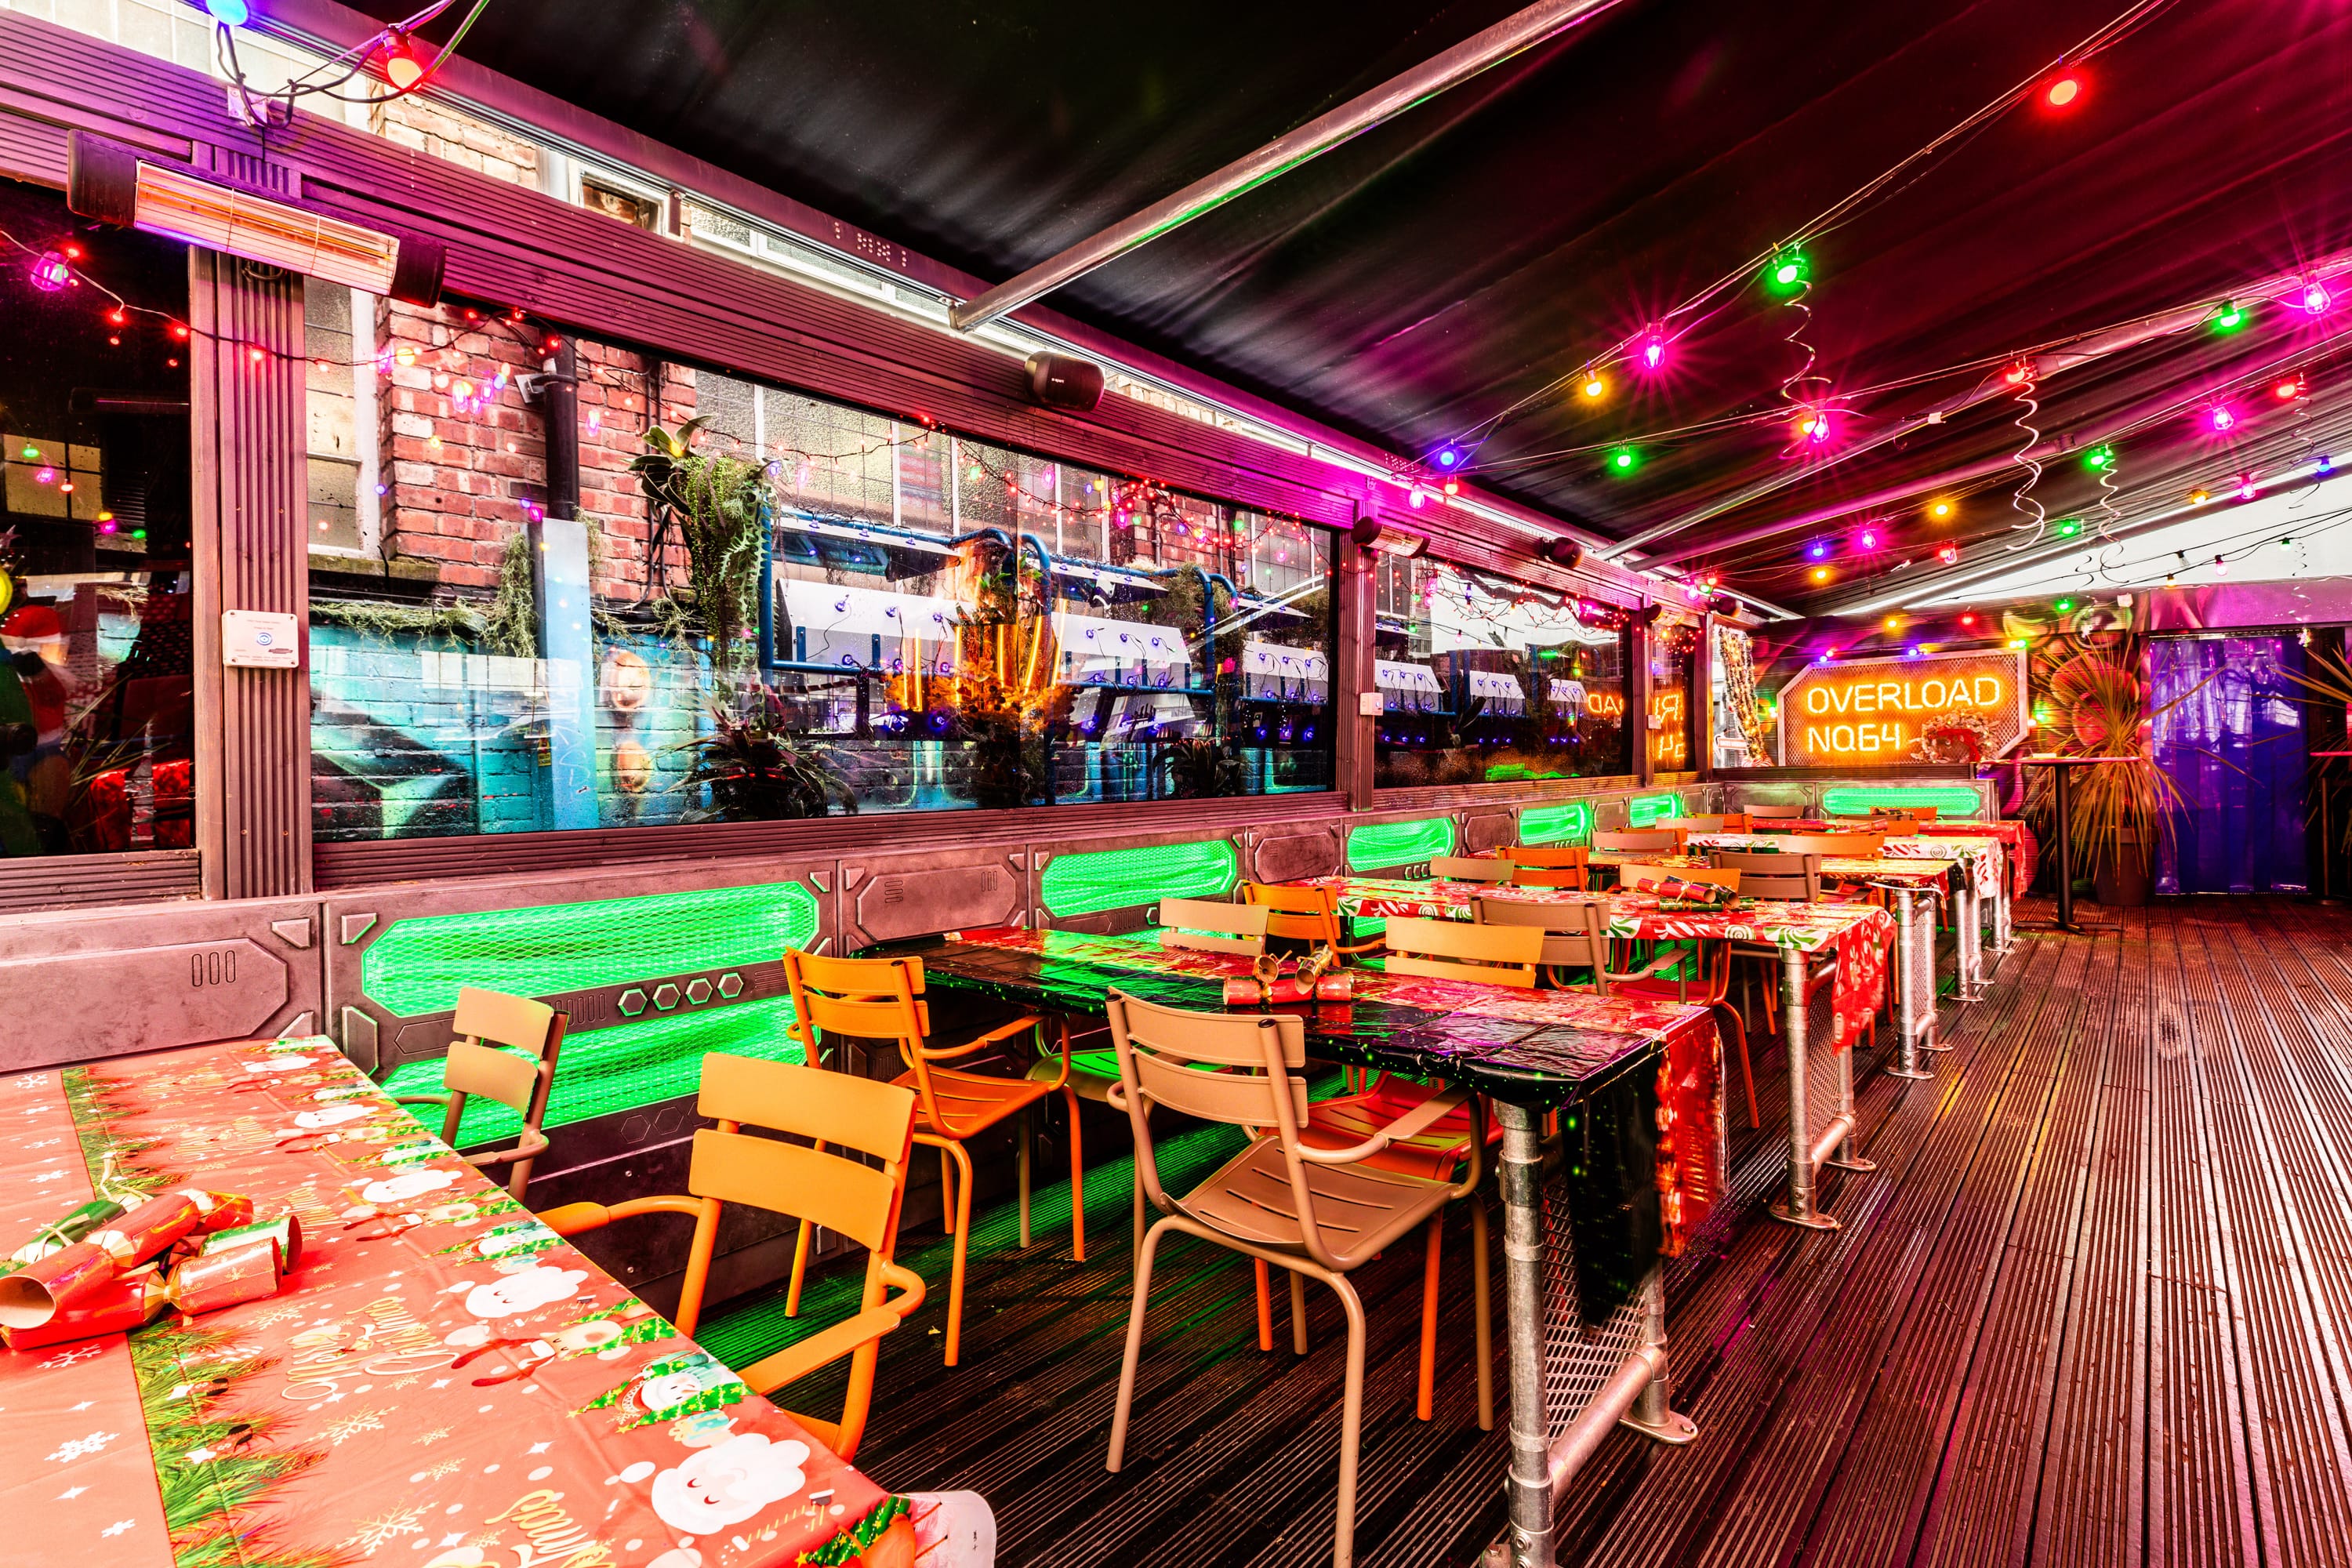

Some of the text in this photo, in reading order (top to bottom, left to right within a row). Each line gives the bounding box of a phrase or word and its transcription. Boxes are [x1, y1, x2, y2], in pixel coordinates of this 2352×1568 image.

[1806, 677, 2001, 714] OVERLOAD
[1807, 723, 1900, 753] NQ64
[345, 1295, 461, 1376] Christmas
[281, 1331, 380, 1400] Merry
